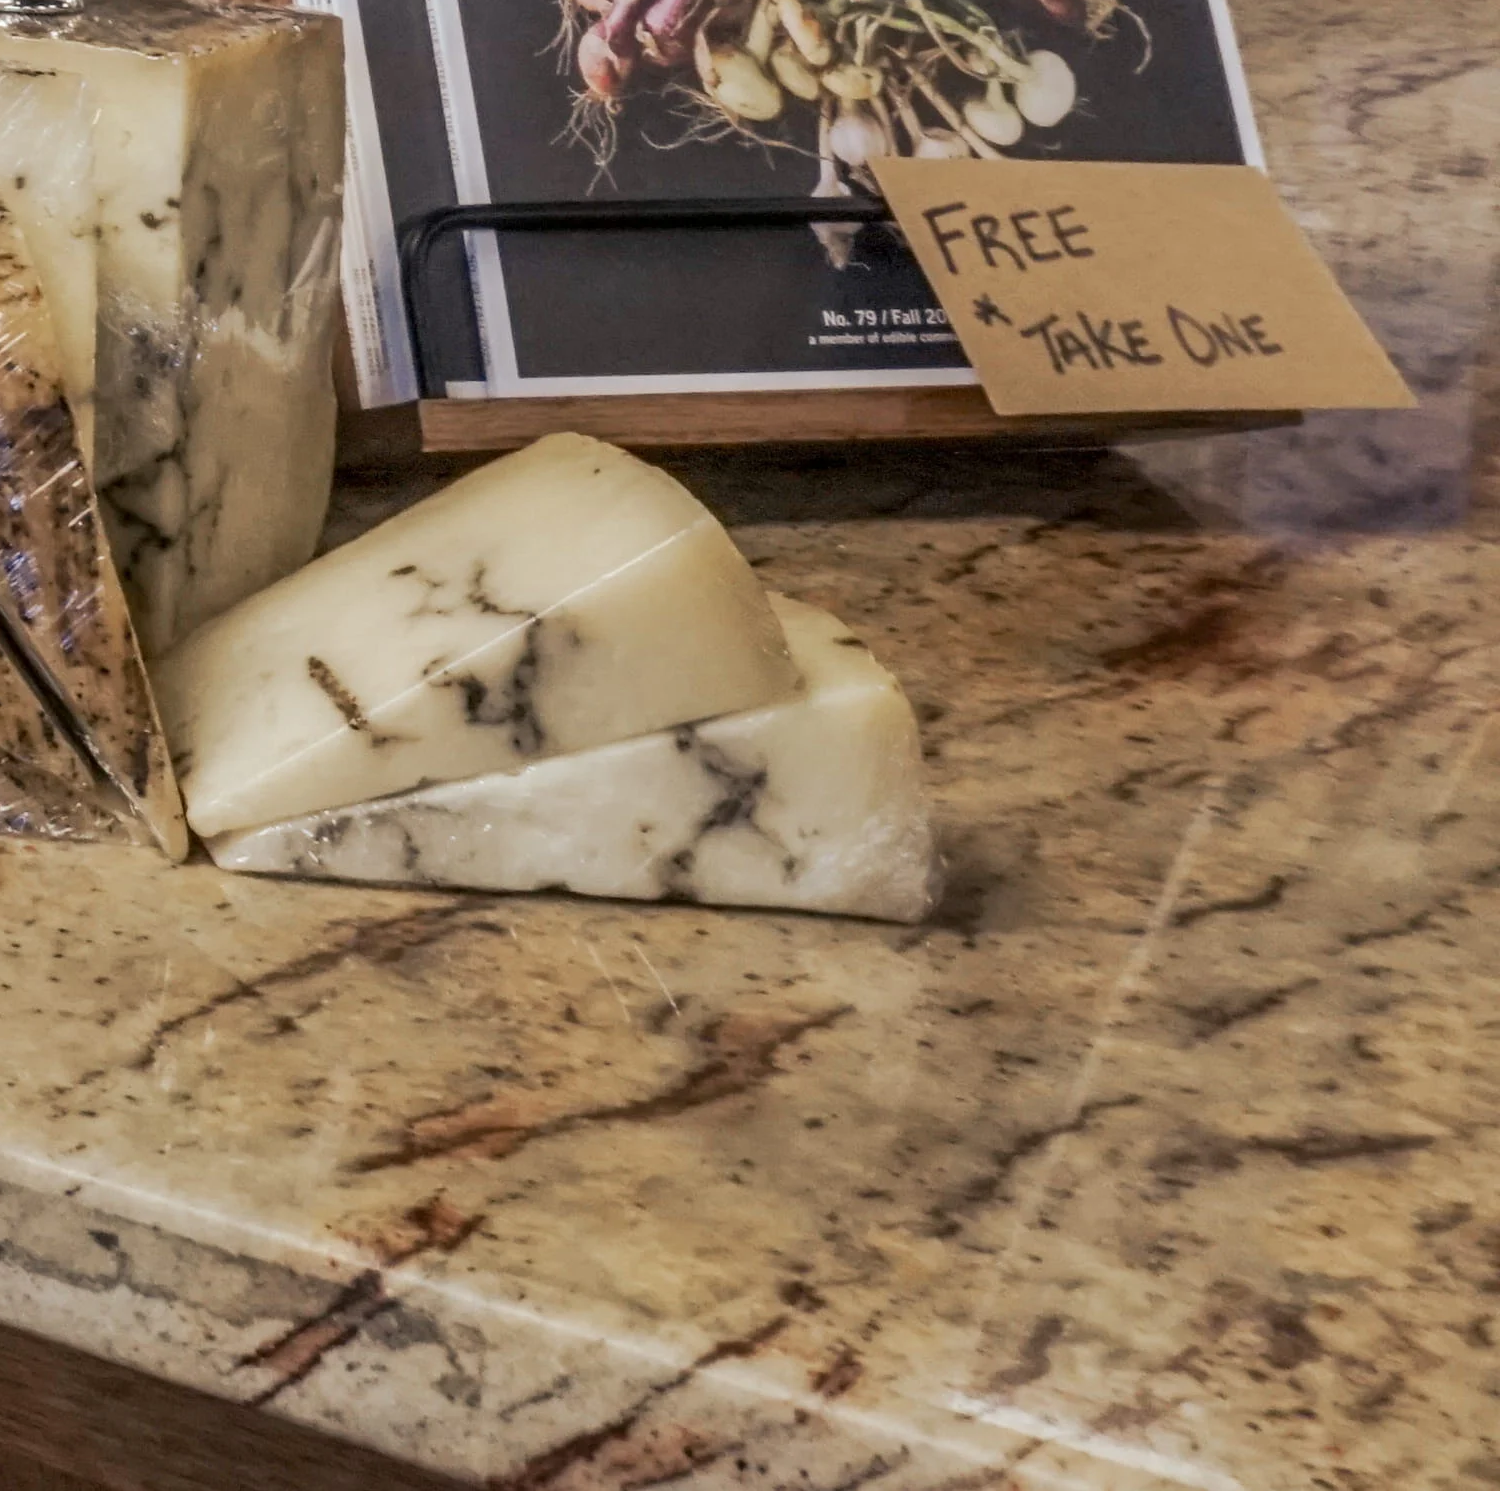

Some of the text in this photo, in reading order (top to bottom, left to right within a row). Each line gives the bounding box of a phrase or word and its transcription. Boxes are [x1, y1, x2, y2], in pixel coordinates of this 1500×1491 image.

[922, 201, 1095, 275] FREE
[823, 309, 851, 328] No.
[854, 309, 877, 327] 79
[892, 308, 921, 326] Fall
[924, 307, 946, 326] 20
[881, 331, 916, 344] edible
[1020, 304, 1284, 376] TAKE ONE
